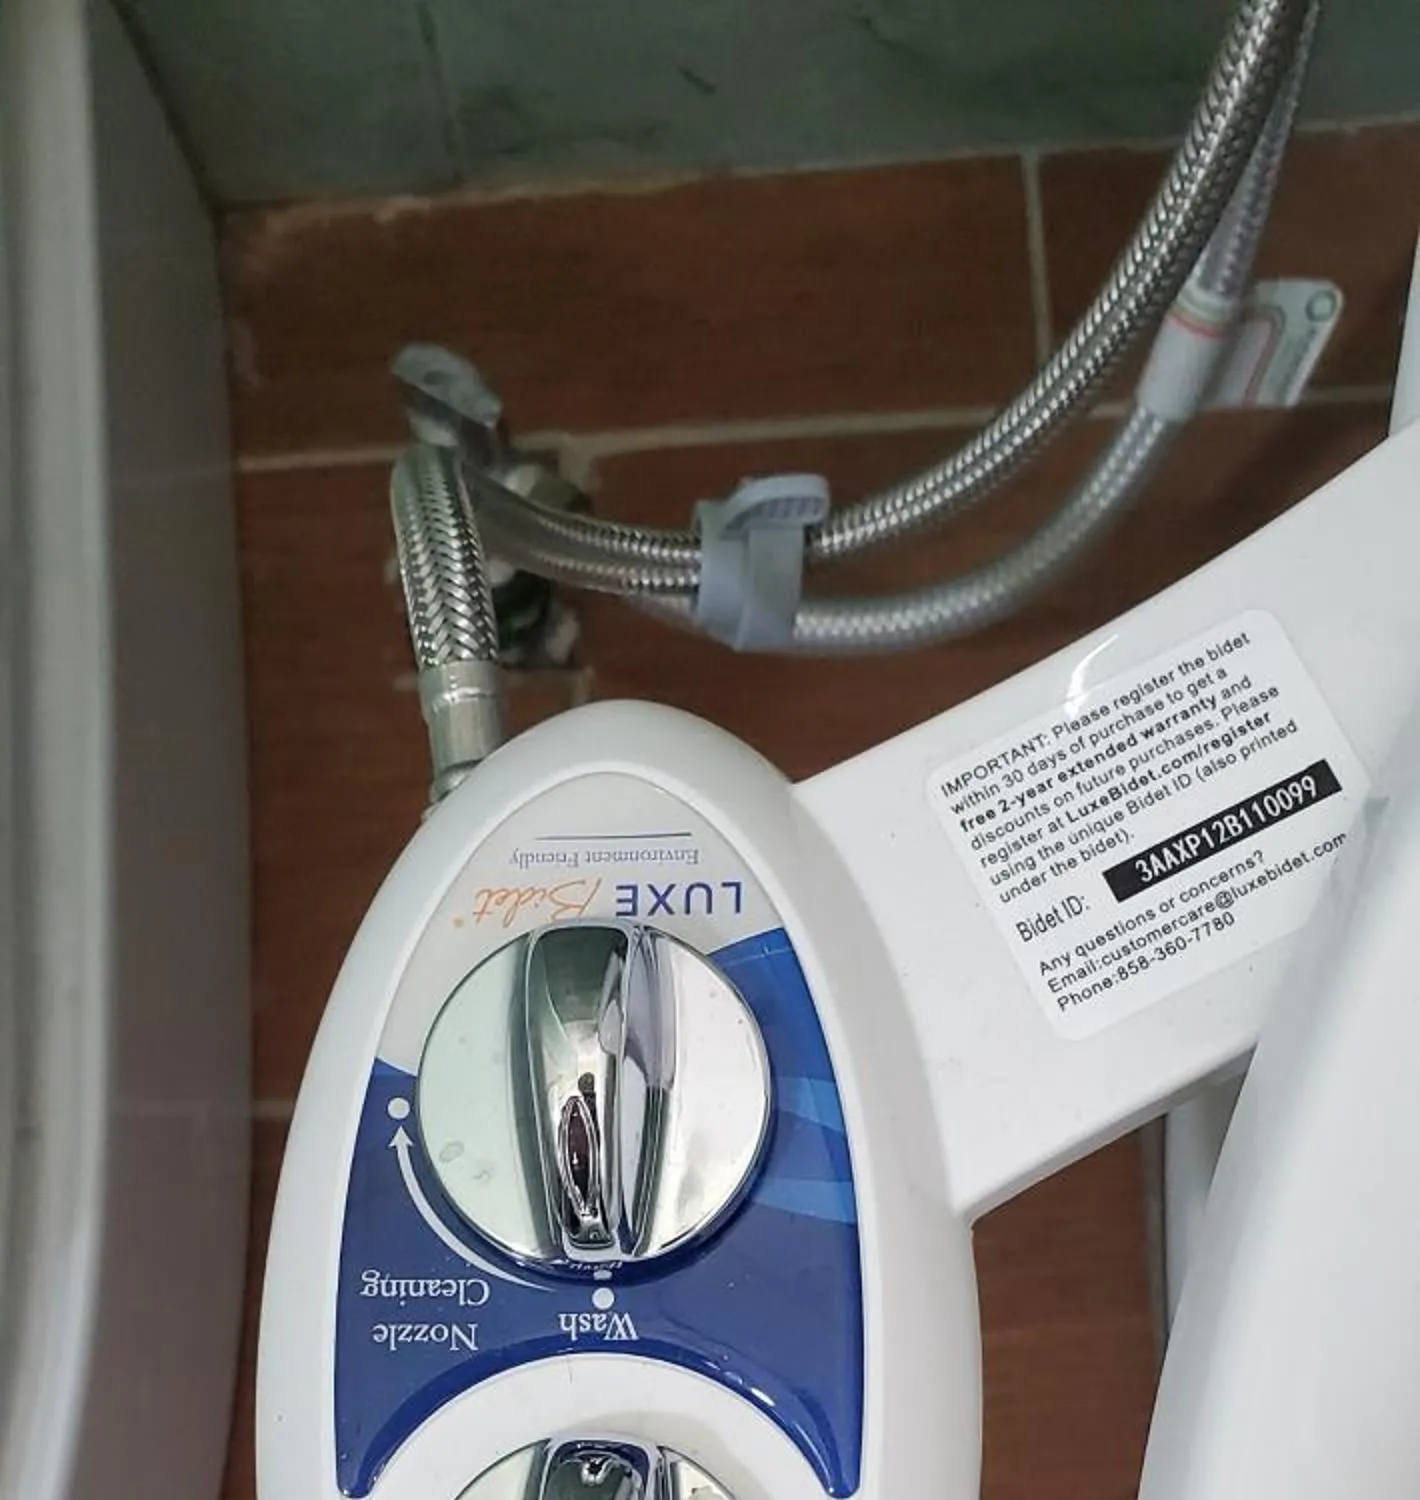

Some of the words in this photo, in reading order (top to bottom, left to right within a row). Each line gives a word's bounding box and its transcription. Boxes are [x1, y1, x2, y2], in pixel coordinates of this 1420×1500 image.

[941, 733, 1050, 797] IMPORTANT:
[1051, 705, 1110, 739] Please
[1113, 670, 1174, 709] register
[1178, 657, 1205, 676] the
[1206, 632, 1250, 661] bidet
[950, 783, 1001, 814] within
[1002, 769, 1024, 788] 30
[1027, 751, 1067, 776] days
[1069, 736, 1086, 754] of
[1089, 700, 1164, 746] purchase
[1166, 689, 1184, 704] to
[1187, 672, 1214, 697] get
[1216, 668, 1228, 680] a
[960, 808, 997, 832] free
[998, 778, 1053, 813] 2-year
[1058, 733, 1138, 783] extended
[1140, 695, 1217, 739] warranty
[1220, 675, 1252, 700] and
[971, 802, 1050, 850] discounts
[1054, 790, 1075, 808] on
[1076, 764, 1126, 795] future
[1128, 719, 1219, 772] purchases.
[1220, 686, 1280, 720] Please
[980, 827, 1044, 868] register
[1048, 816, 1065, 833] at
[1066, 712, 1271, 823] LuxeBidet.com/register
[990, 857, 1037, 886] using
[1038, 841, 1065, 860] the
[1069, 810, 1125, 845] unique
[1126, 785, 1172, 815] Bidet
[1172, 773, 1192, 791] ID
[1196, 752, 1237, 782] (also
[1240, 719, 1298, 760] printed
[509, 847, 579, 869] Friendly
[584, 848, 699, 866] Environment
[616, 881, 742, 916] LUXE
[1000, 871, 1047, 903] under
[1050, 857, 1078, 877] the
[1080, 828, 1134, 862] bidet).
[1016, 907, 1064, 942] Bidet
[1061, 895, 1090, 919] ID:
[1135, 775, 1317, 882] 3AAXP12B110099
[1039, 953, 1072, 976] Any
[1075, 909, 1156, 957] questions
[1159, 898, 1175, 913] or
[1179, 850, 1264, 902] concerns?
[1057, 911, 1235, 1011] Phone:858-360-7780
[360, 1270, 490, 1306] Cleaning
[373, 1323, 478, 1350] Nozzle
[558, 1313, 639, 1341] Wash
